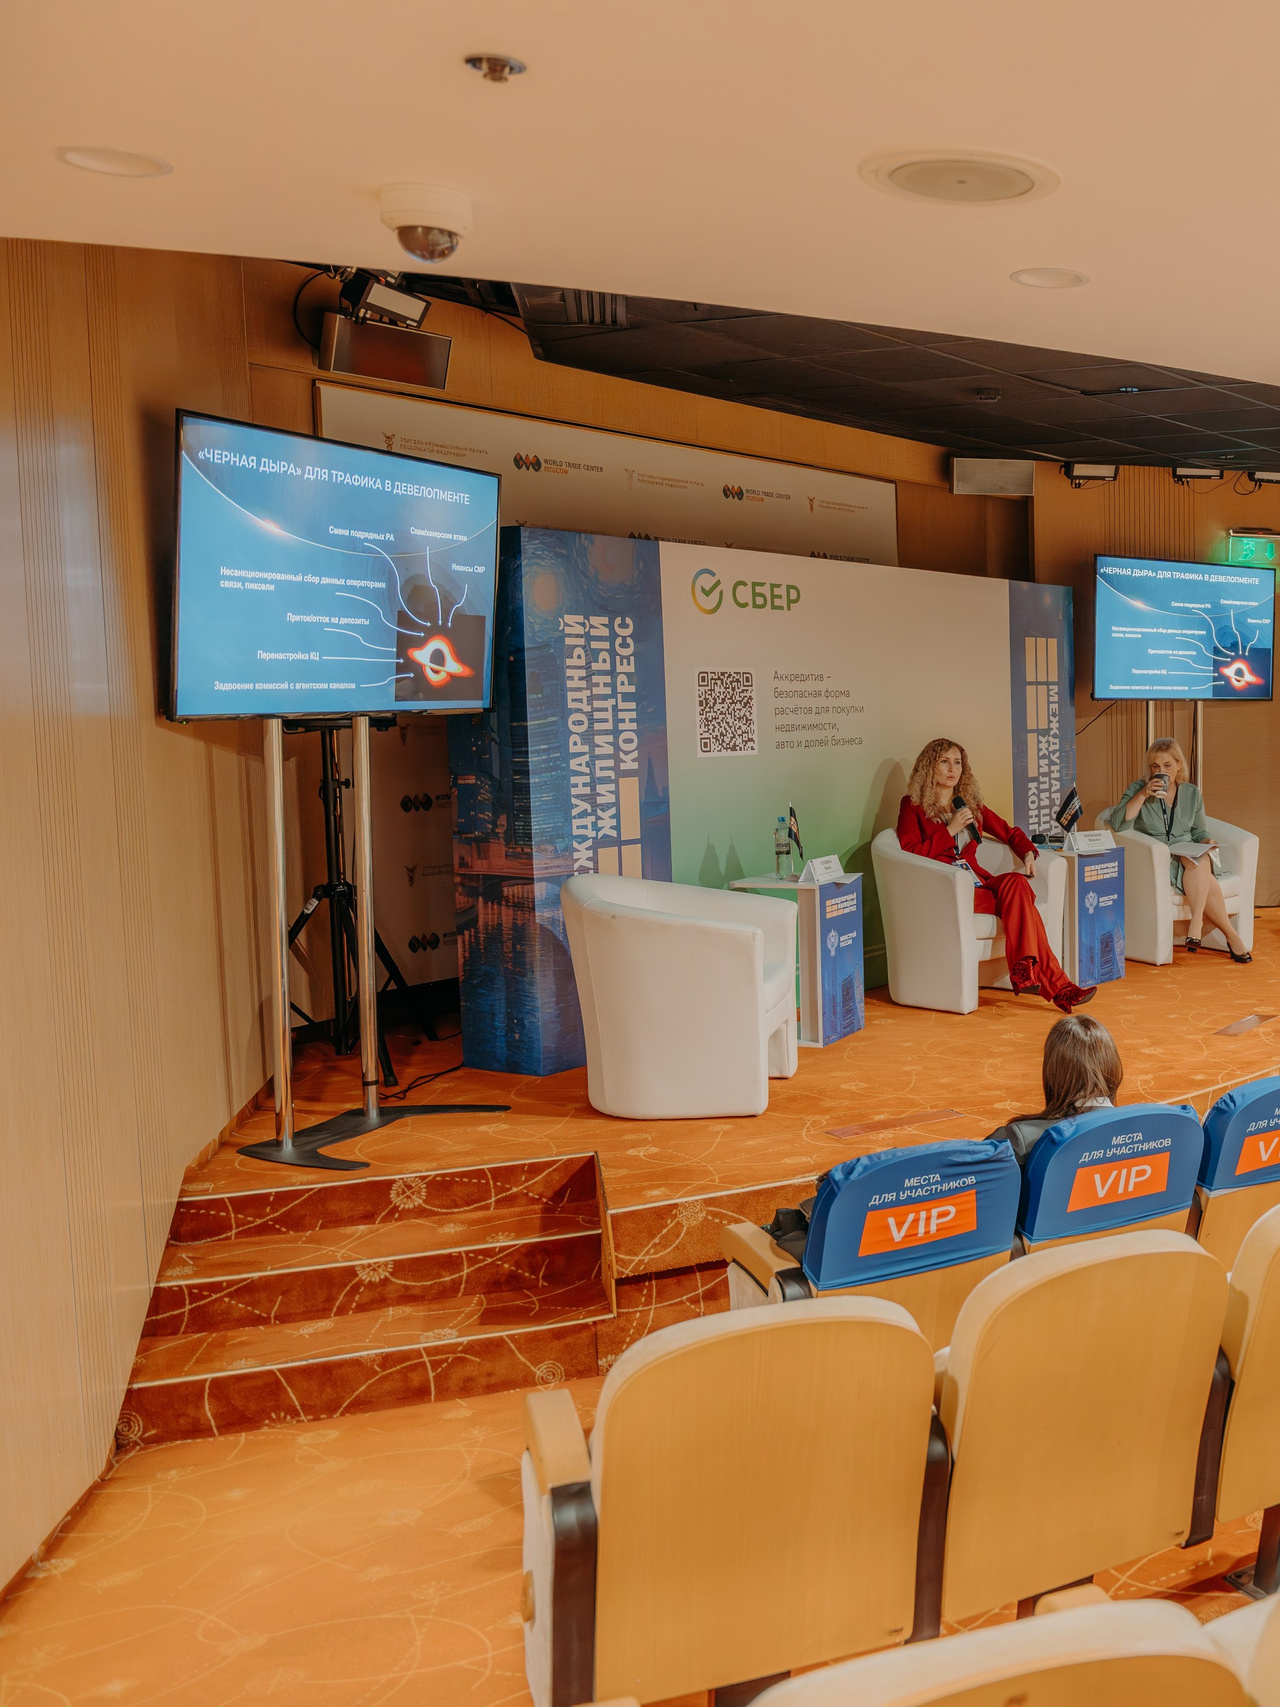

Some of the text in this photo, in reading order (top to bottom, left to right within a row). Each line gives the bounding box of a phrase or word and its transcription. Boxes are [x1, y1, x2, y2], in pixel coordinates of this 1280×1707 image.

[544, 458, 604, 472] WORLD TRADE CENTER
[544, 466, 568, 475] MOSCOW
[198, 448, 470, 505] «ЧЕРНАЯ ДЫРА» ДЛЯ ТРАФИКА В ДЕВЕЛОПМЕНТЕ
[328, 526, 350, 536] Смена
[220, 566, 302, 582] Несанкционированный
[304, 574, 320, 584] сбор
[320, 576, 346, 586] данных
[1100, 566, 1131, 576] «ЧЕРНАЯ
[1132, 568, 1156, 577] ДЫРА»
[1157, 570, 1171, 578] ДЛЯ
[1172, 572, 1203, 580] ТРАФИКА
[1210, 574, 1260, 584] ДЕВЕЛОПМЕНТЕ
[220, 580, 274, 591] связи, пиксели
[732, 580, 801, 611] СБЕР
[331, 616, 338, 624] на
[258, 650, 308, 662] Перенастройка
[773, 670, 824, 683] Аккредитив
[214, 681, 254, 691] Задвоение
[255, 681, 288, 690] комиссий
[614, 616, 639, 770] КОНГРЕСС
[774, 688, 850, 700] безопасная форма
[774, 704, 864, 716] расчётов для покупки
[584, 616, 618, 839] ЖИЛИЩНЫЙ
[775, 721, 840, 734] недвижимости,
[559, 614, 594, 876] ЖДУНАРОДНЫЙ
[776, 735, 863, 750] авто и долей бизнеса
[1049, 685, 1062, 836] МЕЖДУНАРОД
[1038, 735, 1050, 832] ЖИЛИЩ
[1028, 782, 1039, 834] КОНГ
[1246, 1120, 1268, 1132] ДЛЯ
[1112, 1132, 1143, 1146] МЕСТА
[1079, 1138, 1172, 1164] ДЛЯ УЧАСТНИКОВ
[904, 1174, 942, 1188] МЕСТА
[1094, 1164, 1152, 1198] VIP
[868, 1176, 976, 1207] ДЛЯ УЧАСТНИКОВ
[887, 1205, 956, 1242] VIP
